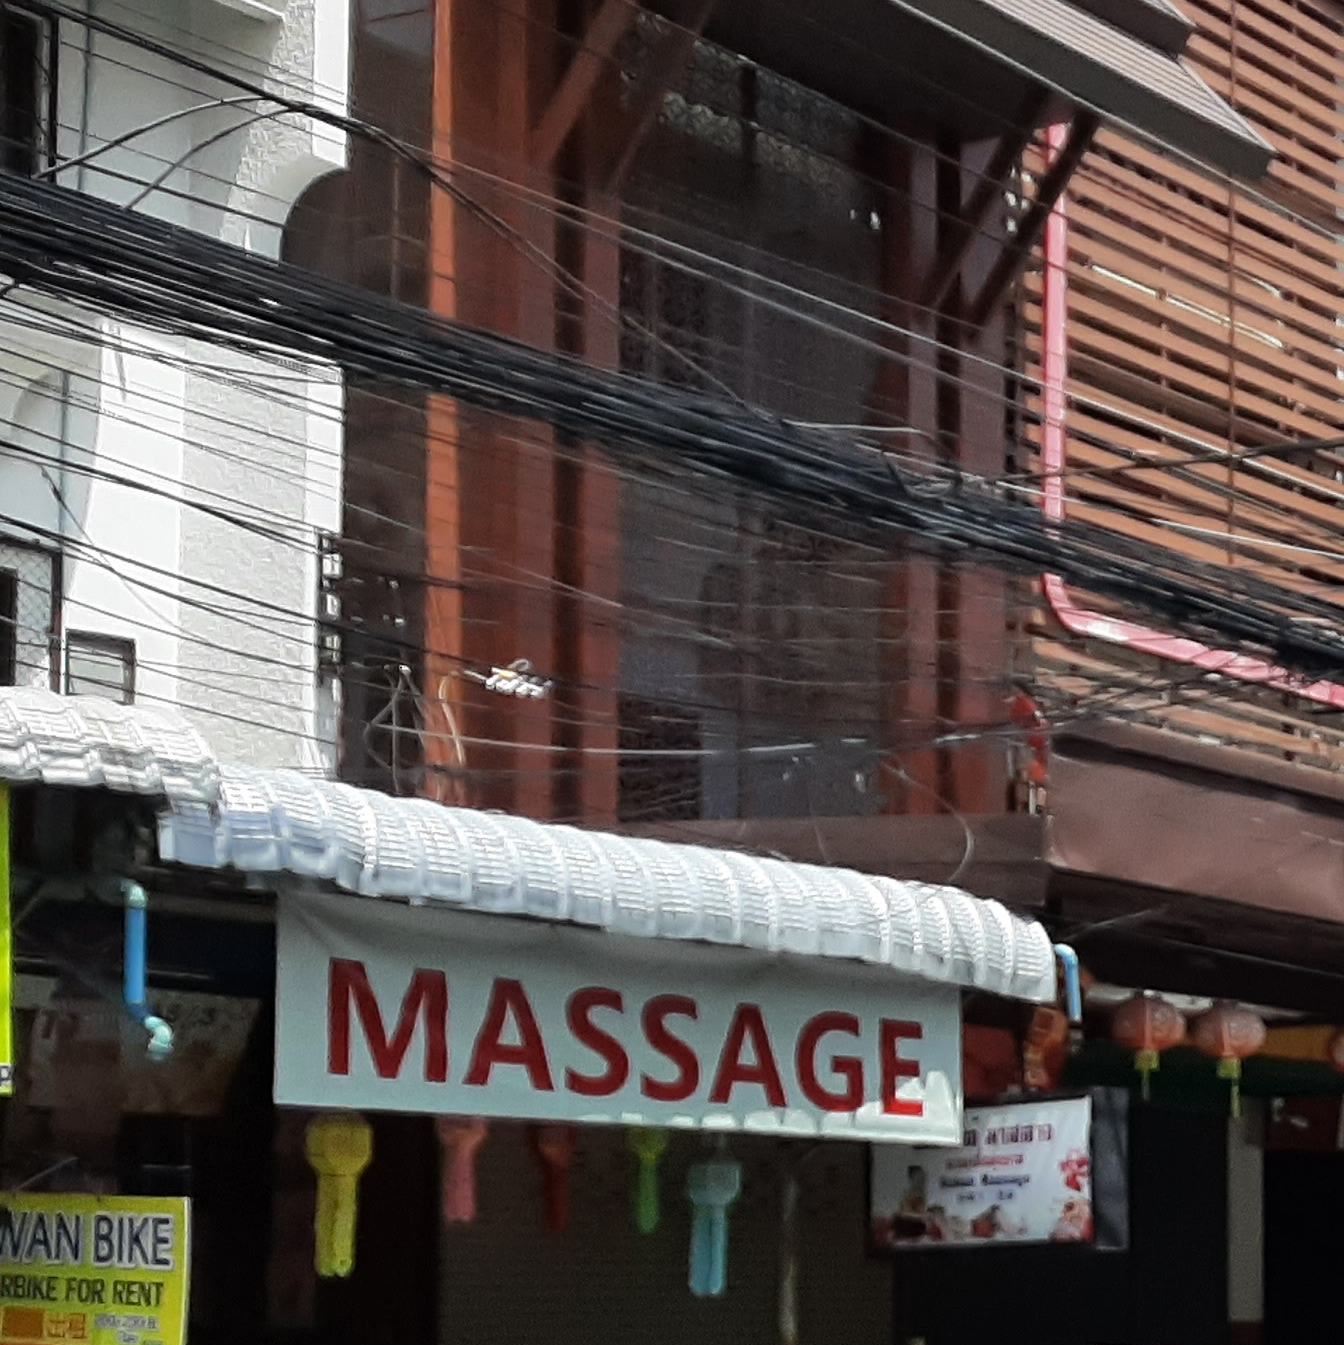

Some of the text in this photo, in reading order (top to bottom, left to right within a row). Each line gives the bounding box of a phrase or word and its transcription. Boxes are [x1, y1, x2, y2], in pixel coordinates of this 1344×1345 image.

[326, 956, 925, 1117] MASSAGE
[93, 1212, 173, 1268] BIKE
[64, 1276, 105, 1305] FOR
[112, 1279, 164, 1307] RENT
